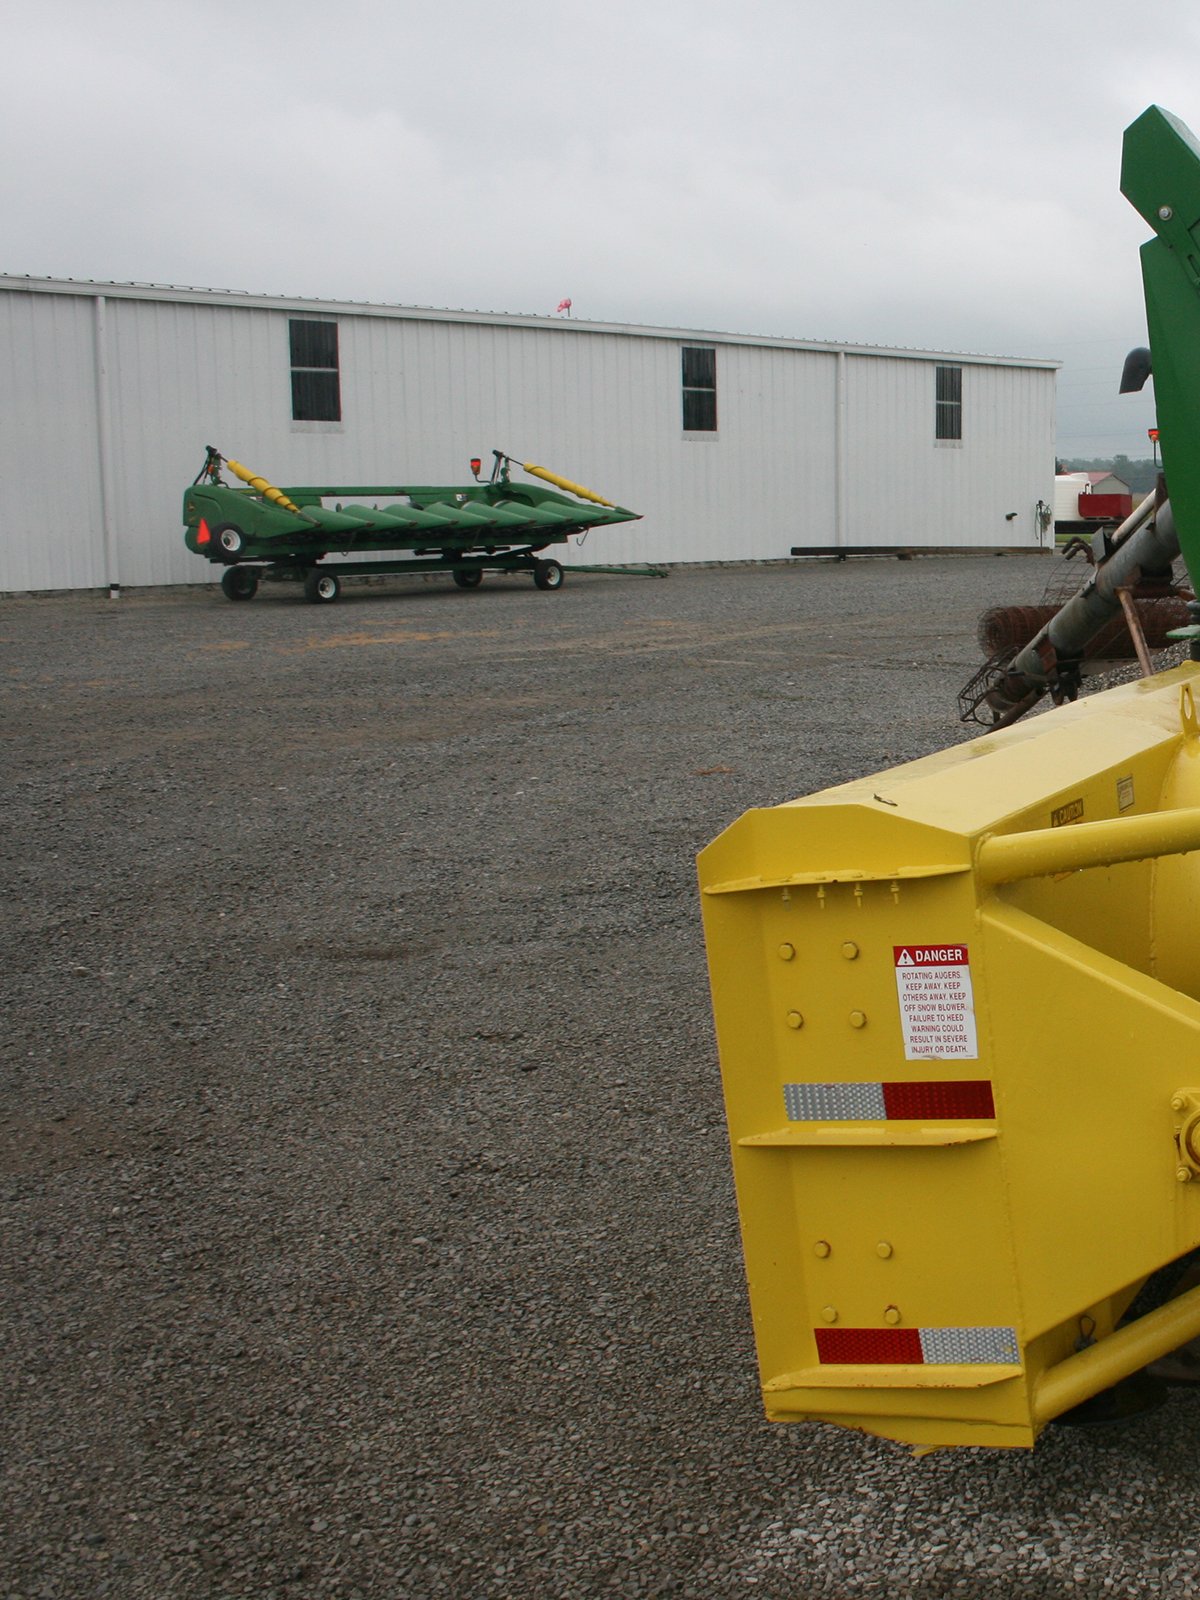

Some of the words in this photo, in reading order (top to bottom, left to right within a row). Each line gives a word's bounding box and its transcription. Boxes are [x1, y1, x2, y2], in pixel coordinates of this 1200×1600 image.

[916, 949, 962, 962] DANGER
[902, 972, 932, 980] ROTATING
[950, 992, 966, 1000] KEEP
